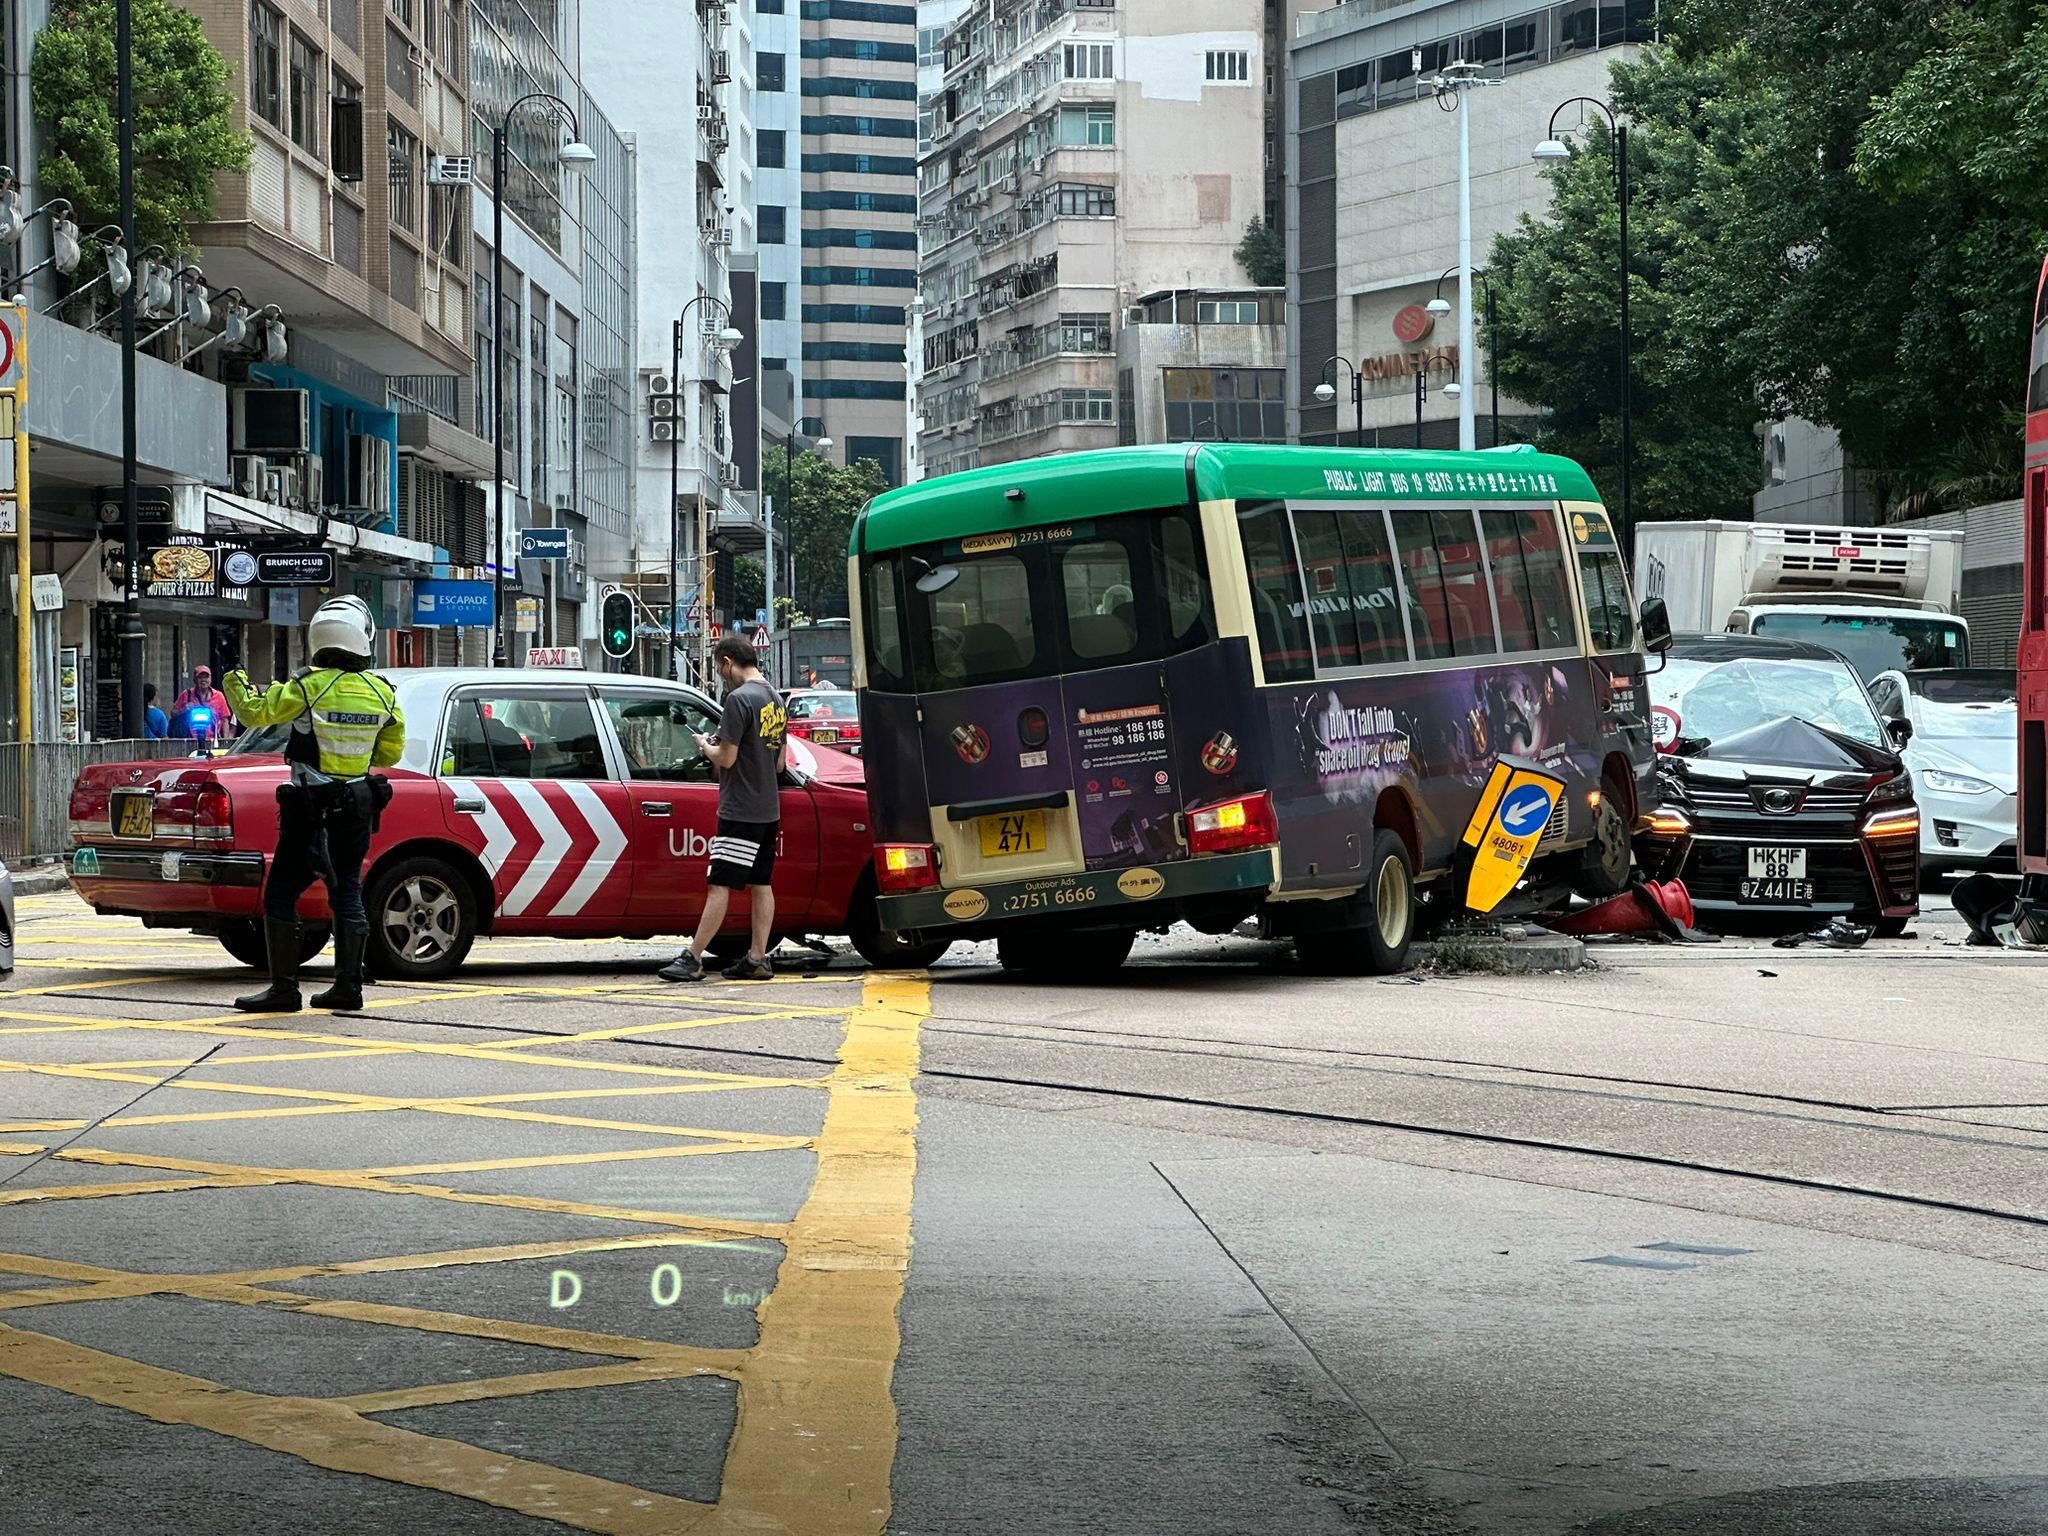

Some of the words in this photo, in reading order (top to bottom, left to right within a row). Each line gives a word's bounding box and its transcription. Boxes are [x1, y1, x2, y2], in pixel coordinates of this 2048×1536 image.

[1323, 470, 1357, 492] PUBLIC
[1359, 472, 1387, 493] LIGHT
[1390, 473, 1410, 493] BUS
[1412, 473, 1423, 493] 19
[1425, 472, 1454, 493] SEATS
[1020, 531, 1044, 543] 2751
[1047, 527, 1073, 540] 6666
[536, 540, 566, 549] Towngas
[265, 558, 301, 567] BRUNCH
[301, 558, 323, 566] CLUB
[147, 582, 177, 596] MOTHER
[186, 582, 215, 596] PIZZAS
[439, 595, 489, 605] ESCAPADE
[529, 648, 566, 665] TAXI
[340, 713, 371, 724] POLICE
[1329, 708, 1357, 741] DON'T
[1357, 706, 1375, 737] fall
[1375, 705, 1395, 733] into
[1094, 725, 1122, 736] Hotline:
[1126, 721, 1144, 733] 186
[1146, 719, 1164, 731] 186
[1112, 735, 1125, 746] 98
[1127, 732, 1145, 743] 186
[1147, 729, 1166, 741] 186
[1348, 742, 1360, 769] oil
[1384, 735, 1411, 764] traps!
[998, 832, 1031, 851] 471
[1492, 837, 1524, 854] 48061
[1754, 848, 1802, 864] HKHF
[1765, 863, 1789, 878] 88
[1025, 879, 1059, 891] Outdoor
[1060, 877, 1076, 887] Ads
[1011, 891, 1049, 910] 2751
[1055, 886, 1097, 905] 6666
[550, 1270, 582, 1308] D
[650, 1263, 682, 1306] 0
